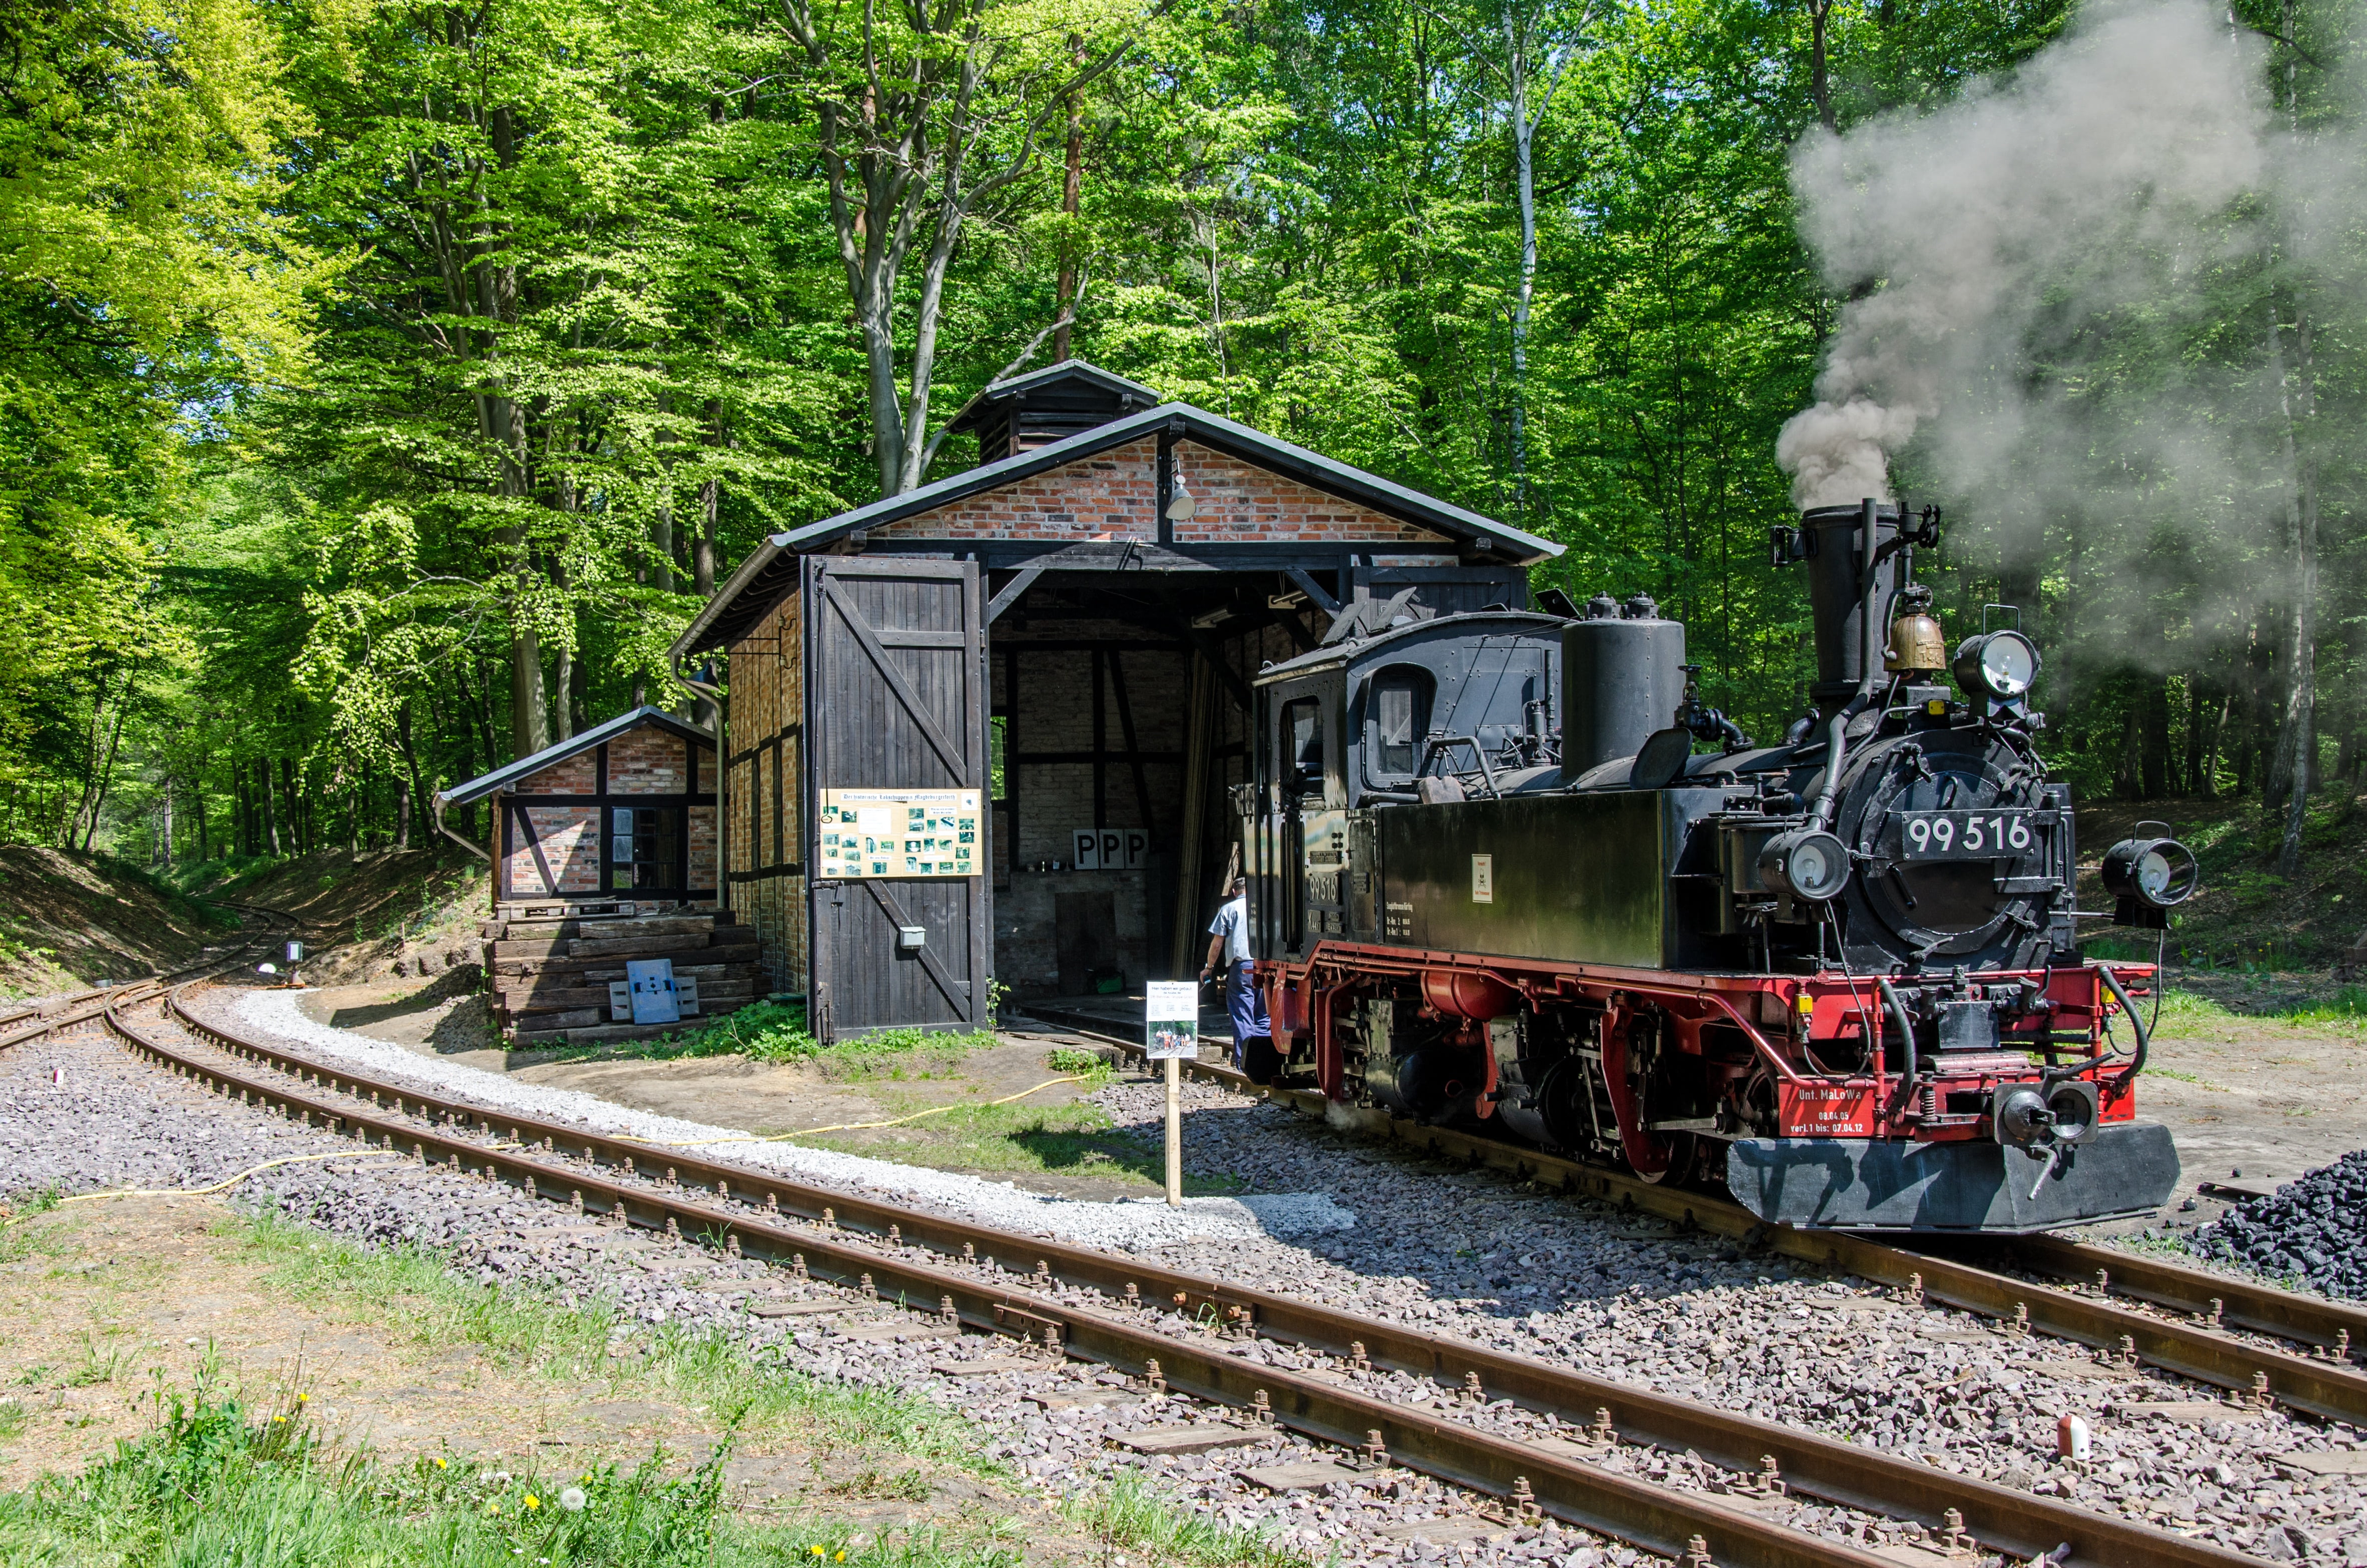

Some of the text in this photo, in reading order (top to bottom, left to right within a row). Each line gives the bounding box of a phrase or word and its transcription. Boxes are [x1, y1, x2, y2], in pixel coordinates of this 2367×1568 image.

[1909, 816, 2030, 853] 99 516
[1310, 877, 1320, 900] 99
[1321, 877, 1336, 901] 516
[1799, 1089, 1861, 1100] Unt. MaLoWa
[1819, 1112, 1849, 1120] 08.04.05
[1816, 1124, 1829, 1132] bis:
[1832, 1124, 1863, 1132] 07.04.12
